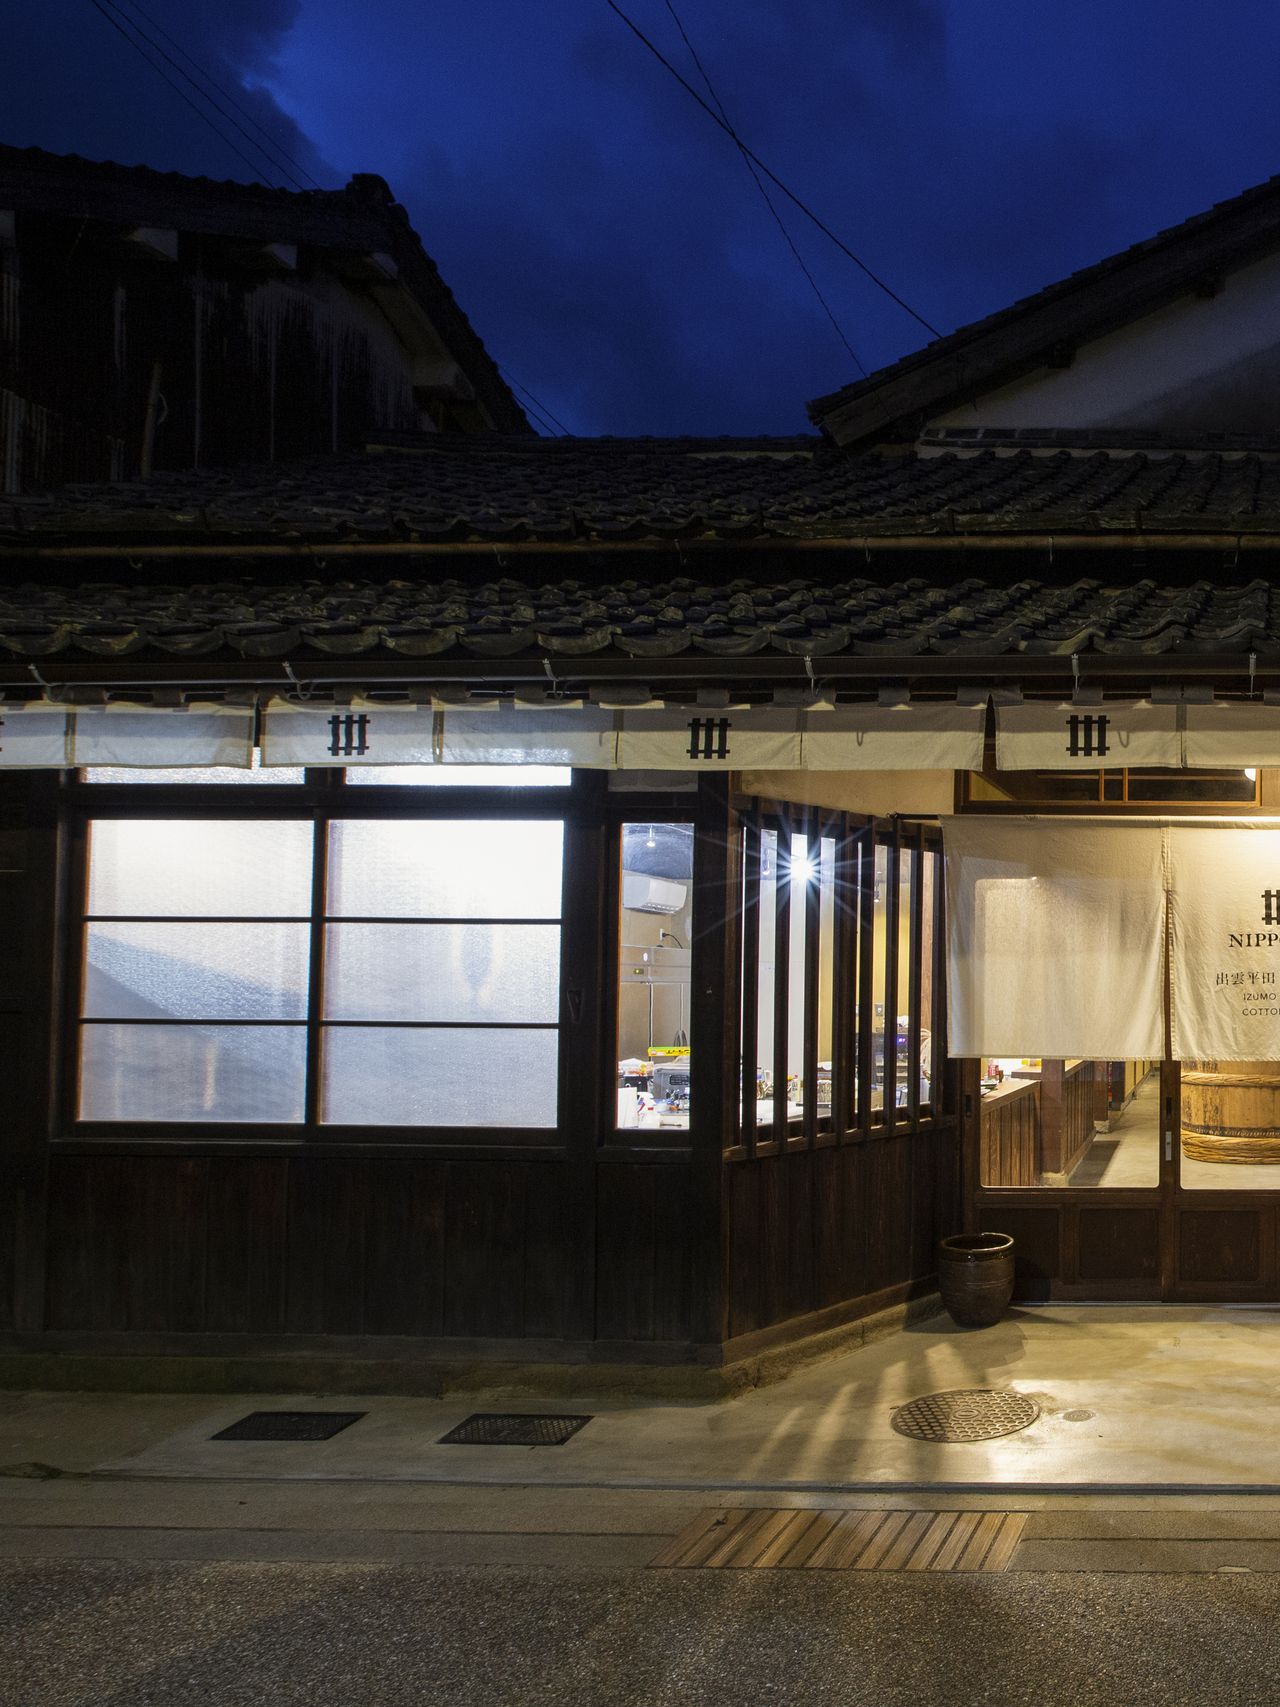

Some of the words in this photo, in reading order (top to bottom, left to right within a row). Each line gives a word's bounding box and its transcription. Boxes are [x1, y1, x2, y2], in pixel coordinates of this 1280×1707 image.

[1215, 971, 1275, 986] 出雲平田
[1243, 992, 1277, 1001] IZUMO
